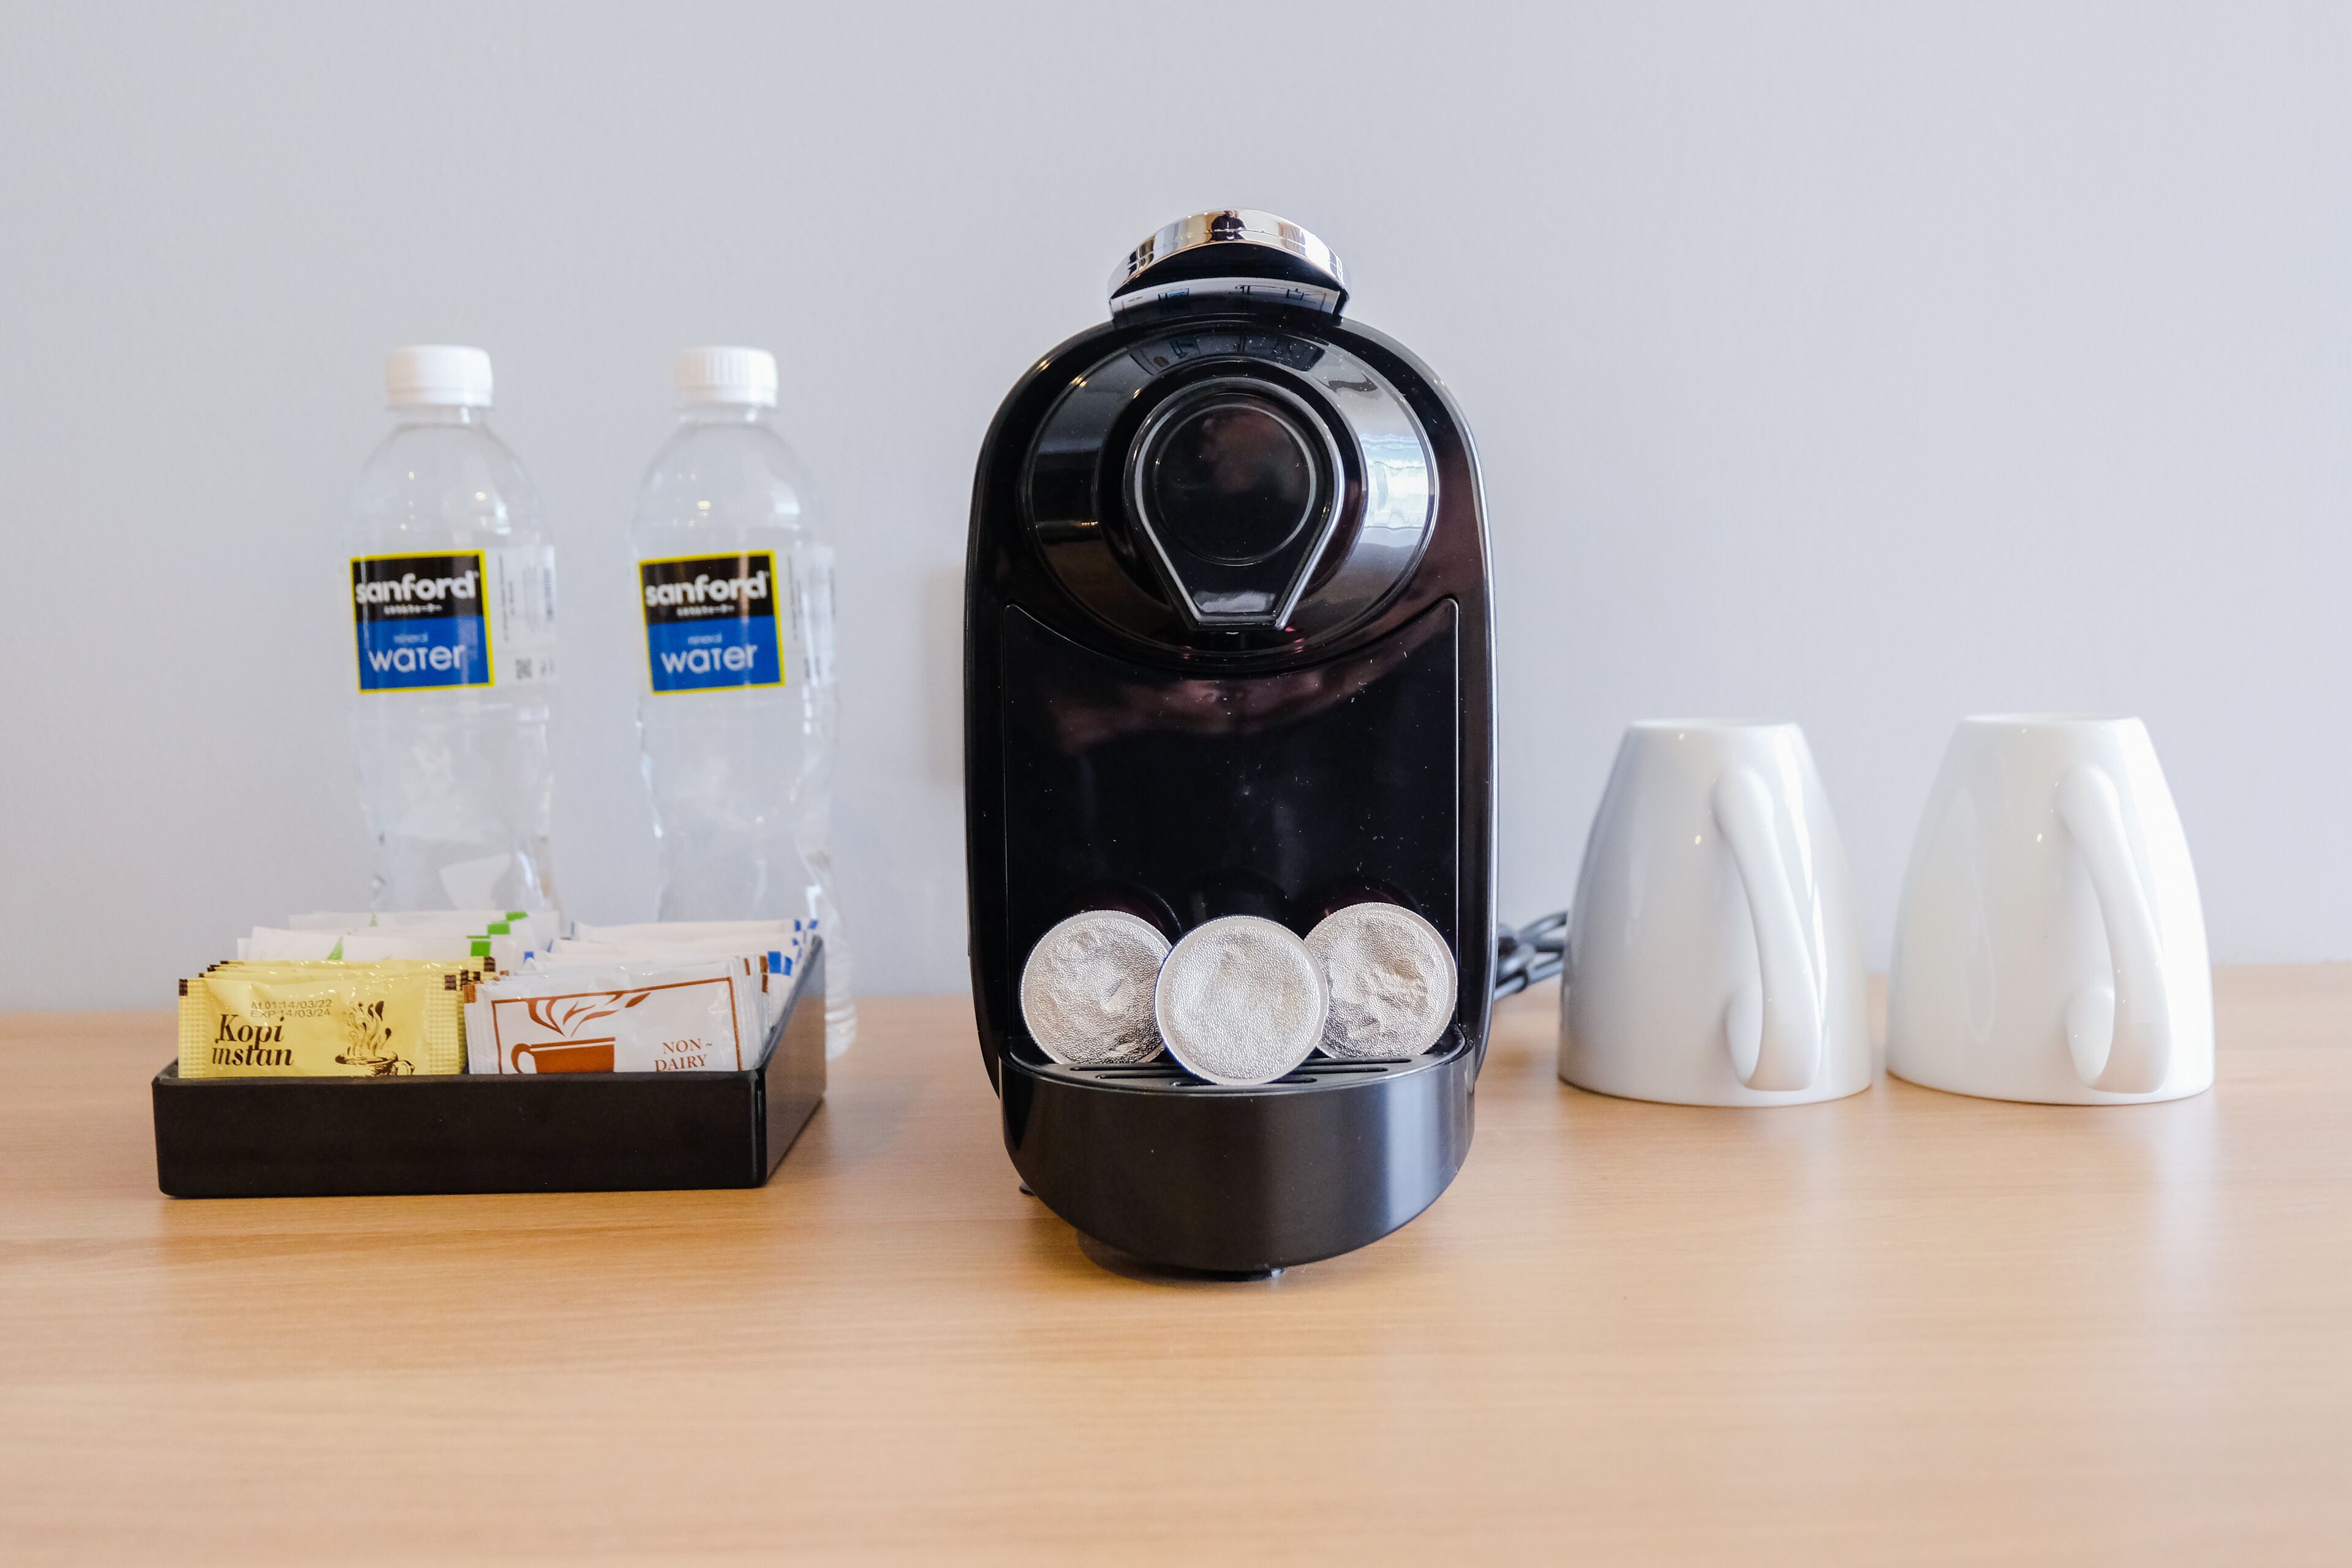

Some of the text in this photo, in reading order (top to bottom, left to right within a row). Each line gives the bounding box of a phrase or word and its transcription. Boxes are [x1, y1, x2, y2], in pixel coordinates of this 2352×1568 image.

[355, 570, 477, 604] sanford
[644, 570, 767, 606] sanford
[369, 645, 467, 673] water
[660, 645, 758, 674] water
[215, 1014, 285, 1050] Kopi
[212, 1045, 294, 1066] instan
[654, 1054, 707, 1072] DAIRY
